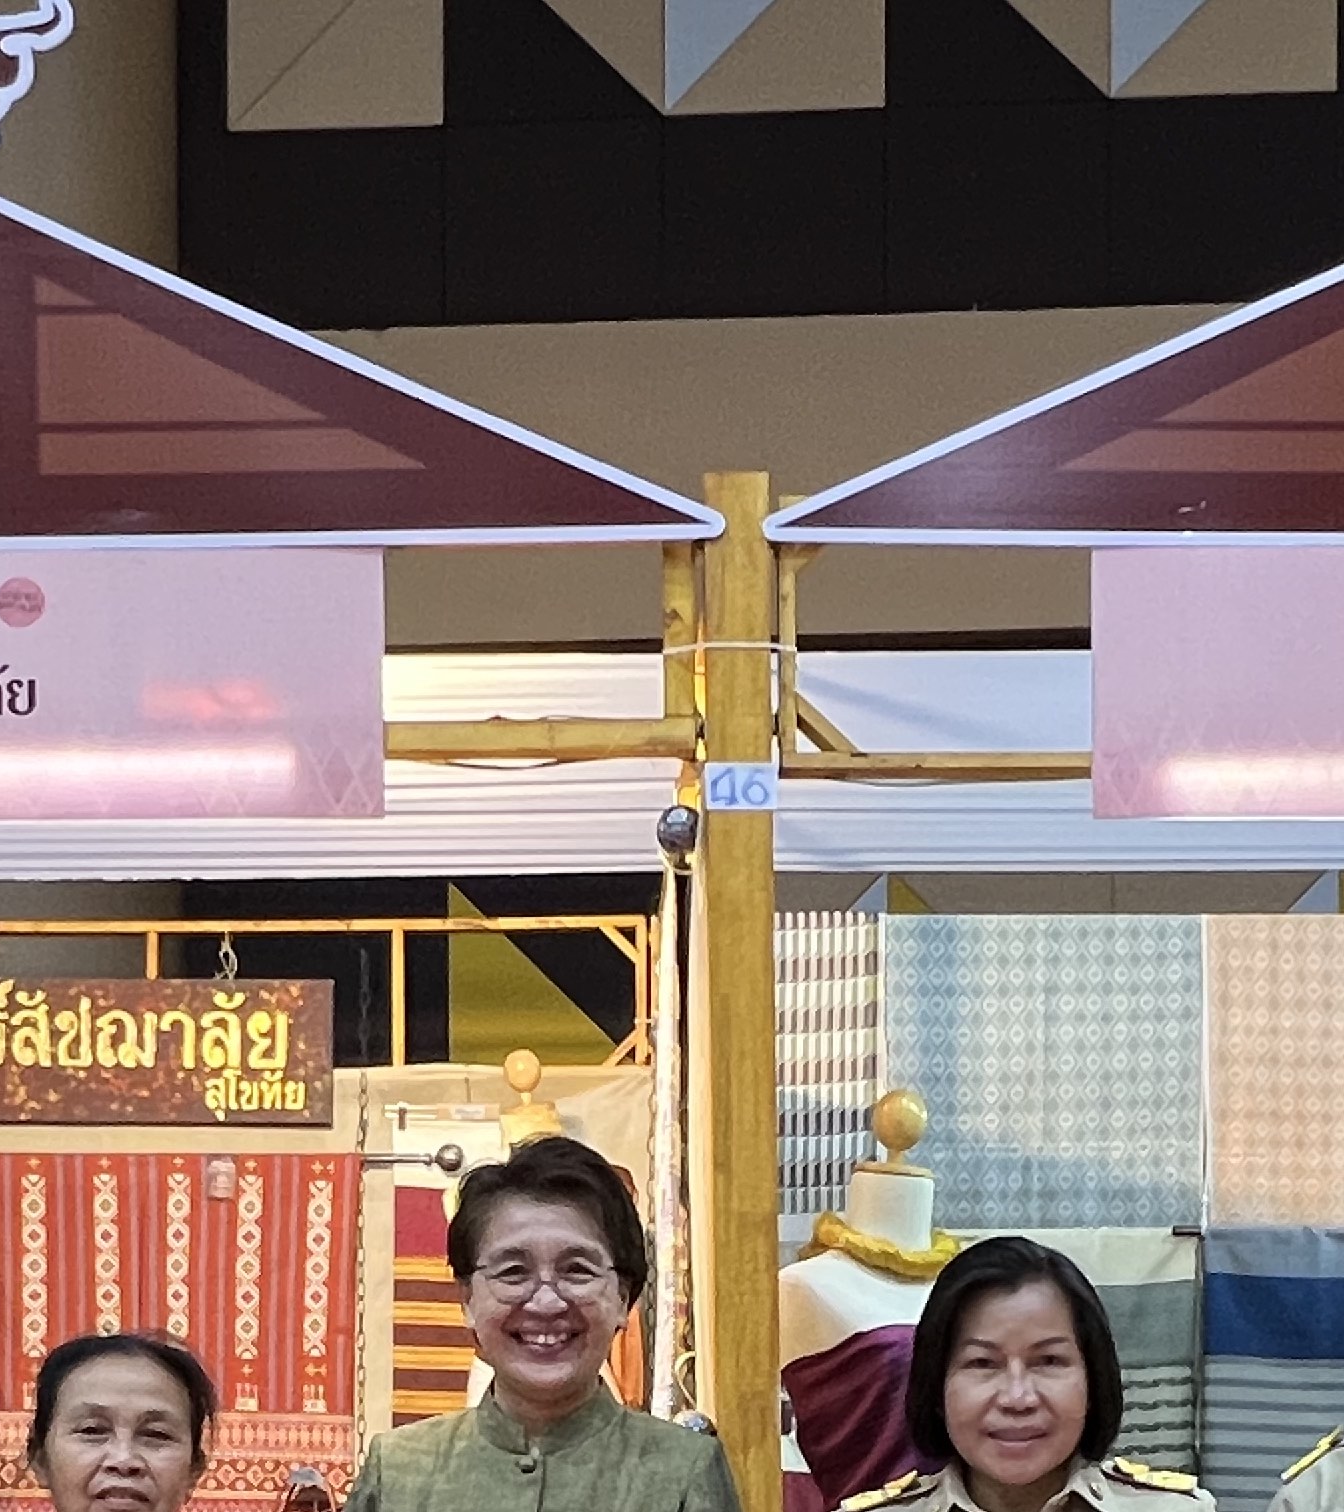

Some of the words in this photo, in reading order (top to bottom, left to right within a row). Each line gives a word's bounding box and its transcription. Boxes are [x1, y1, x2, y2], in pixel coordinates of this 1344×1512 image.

[710, 767, 770, 806] 46
[204, 1068, 306, 1122] สุโขทัย
